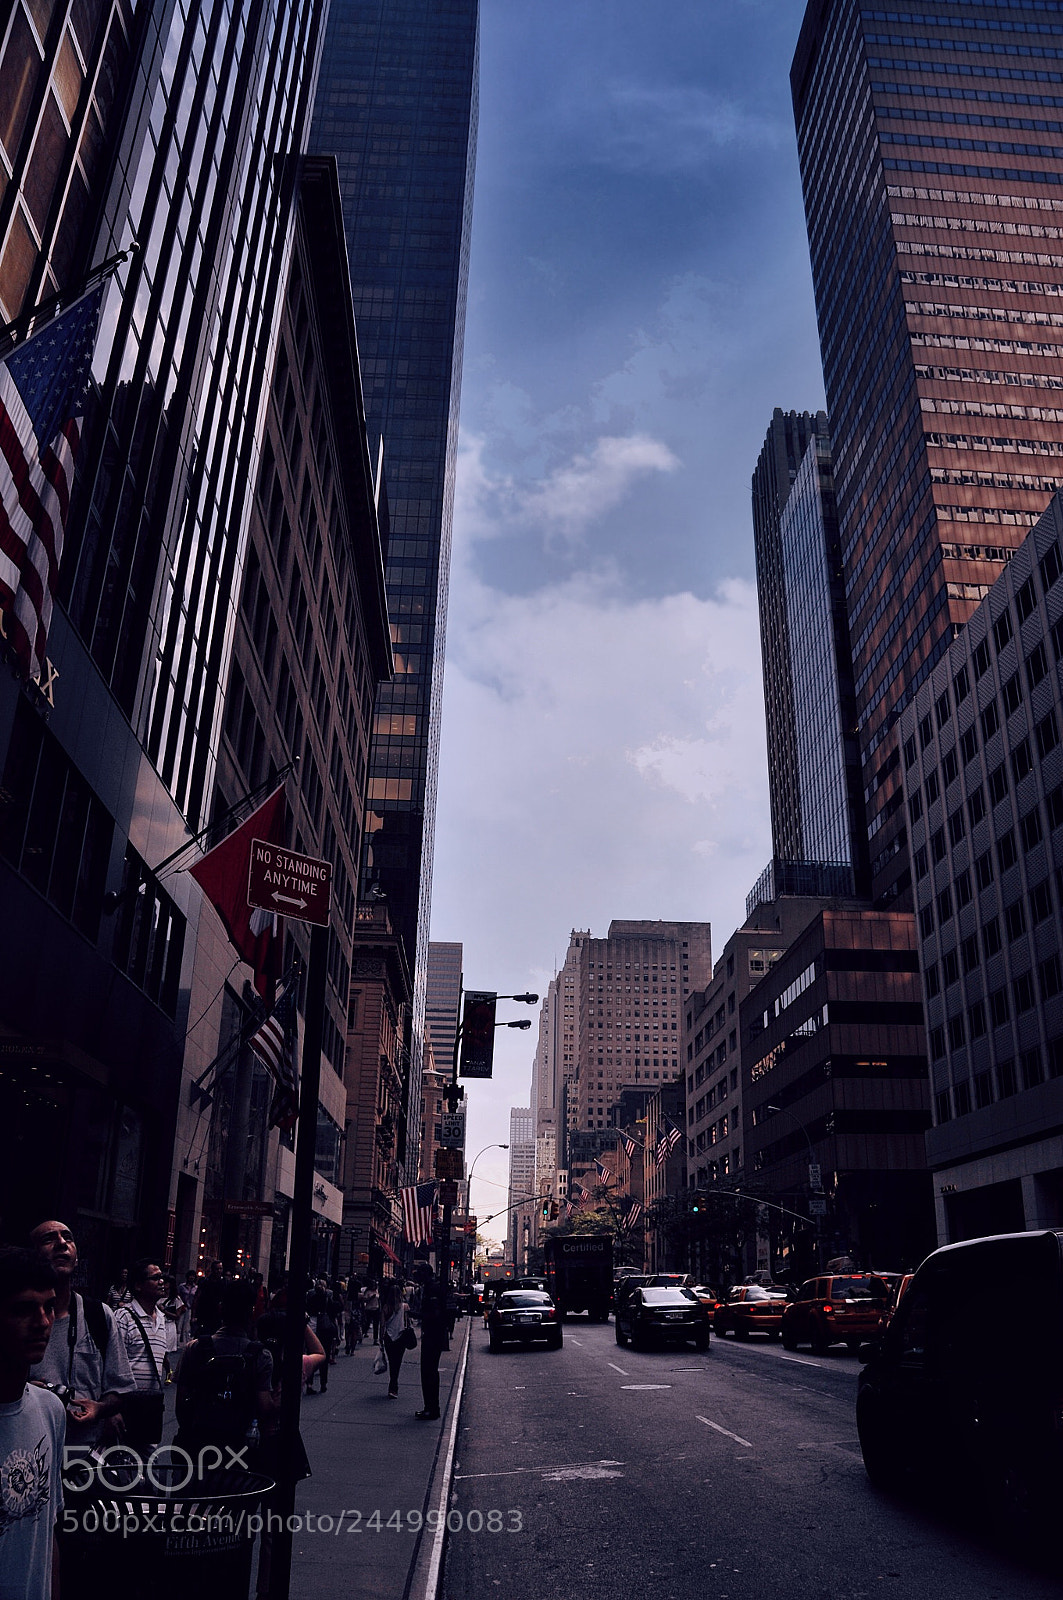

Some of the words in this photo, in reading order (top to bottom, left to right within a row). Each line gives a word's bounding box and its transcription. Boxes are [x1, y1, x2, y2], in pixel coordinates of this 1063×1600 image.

[256, 848, 271, 864] NO
[276, 854, 327, 881] STANDING
[263, 869, 318, 896] ANYTIME
[443, 1127, 461, 1138] 30
[562, 1242, 604, 1253] Certified
[165, 1535, 199, 1549] Fifth
